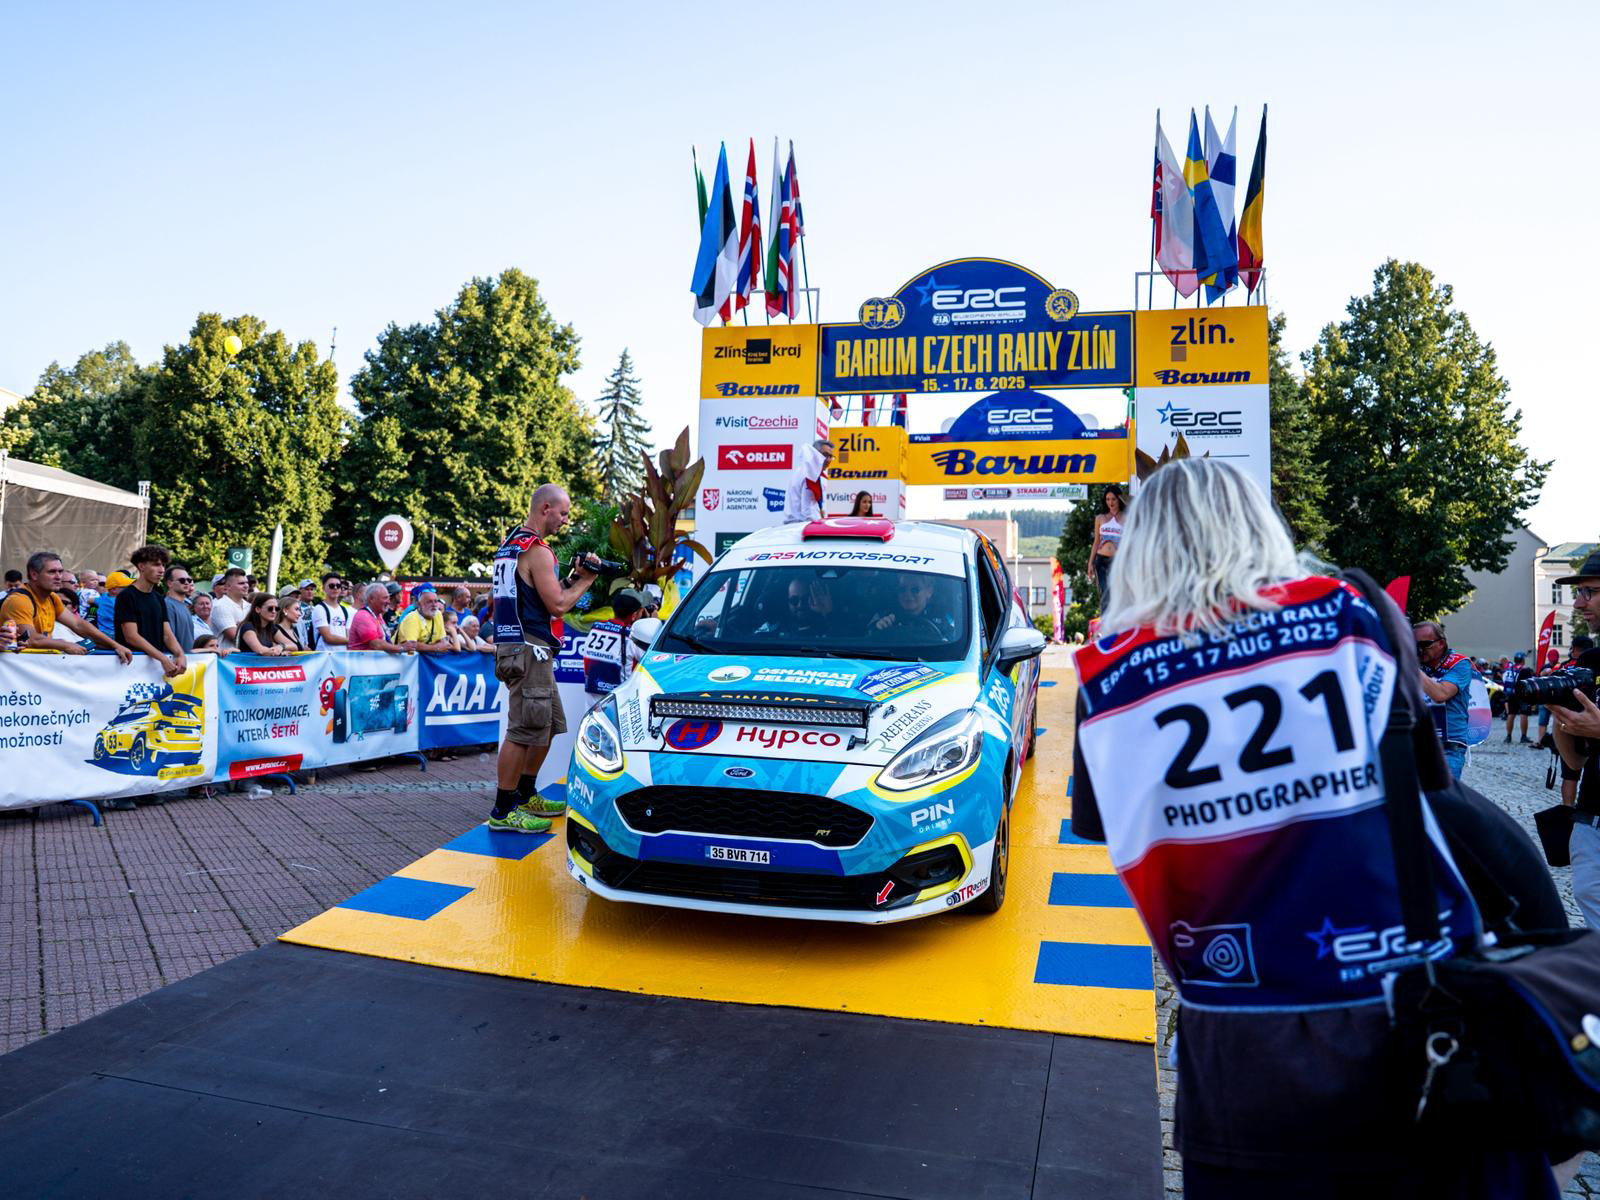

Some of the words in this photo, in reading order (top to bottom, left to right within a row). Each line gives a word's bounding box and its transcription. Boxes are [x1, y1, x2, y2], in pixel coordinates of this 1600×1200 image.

[1170, 317, 1235, 345] zlín.
[772, 344, 801, 358] kraj
[835, 337, 917, 378] BARUM
[923, 335, 992, 374] CZECH
[998, 331, 1062, 371] RALLY
[1066, 325, 1116, 370] ZLÍN
[922, 379, 941, 391] 15.
[953, 378, 972, 391] 17.
[975, 377, 987, 390] 8.
[990, 376, 1025, 389] 2025
[1154, 369, 1251, 384] Barum
[715, 382, 800, 396] Barum
[715, 416, 798, 429] #VisitCzechia
[838, 433, 880, 452] zlín.
[746, 452, 785, 462] ORLEN
[931, 449, 1097, 475] Barum
[828, 467, 888, 478] Barum
[1281, 591, 1345, 622] RALLY
[587, 633, 618, 652] 257
[1143, 665, 1170, 685] 15
[1192, 648, 1220, 667] 17
[1226, 637, 1272, 660] AUG
[1278, 620, 1340, 645] 2025
[252, 669, 302, 681] AVONET
[426, 674, 487, 713] AAA
[224, 704, 310, 723] TROJKOMBINACE,
[880, 699, 932, 742] REFERANS
[237, 725, 270, 743] KTERÁ
[271, 720, 299, 739] ŠETŘÍ
[736, 727, 841, 749] Hypco
[901, 715, 934, 741] CATERING
[1153, 670, 1358, 789] 221
[574, 775, 594, 805] PIN
[1163, 763, 1379, 826] PHOTOGRAPHER
[910, 799, 955, 827] PIN
[712, 847, 724, 858] 35
[727, 849, 747, 861] BVR
[750, 851, 768, 863] 714
